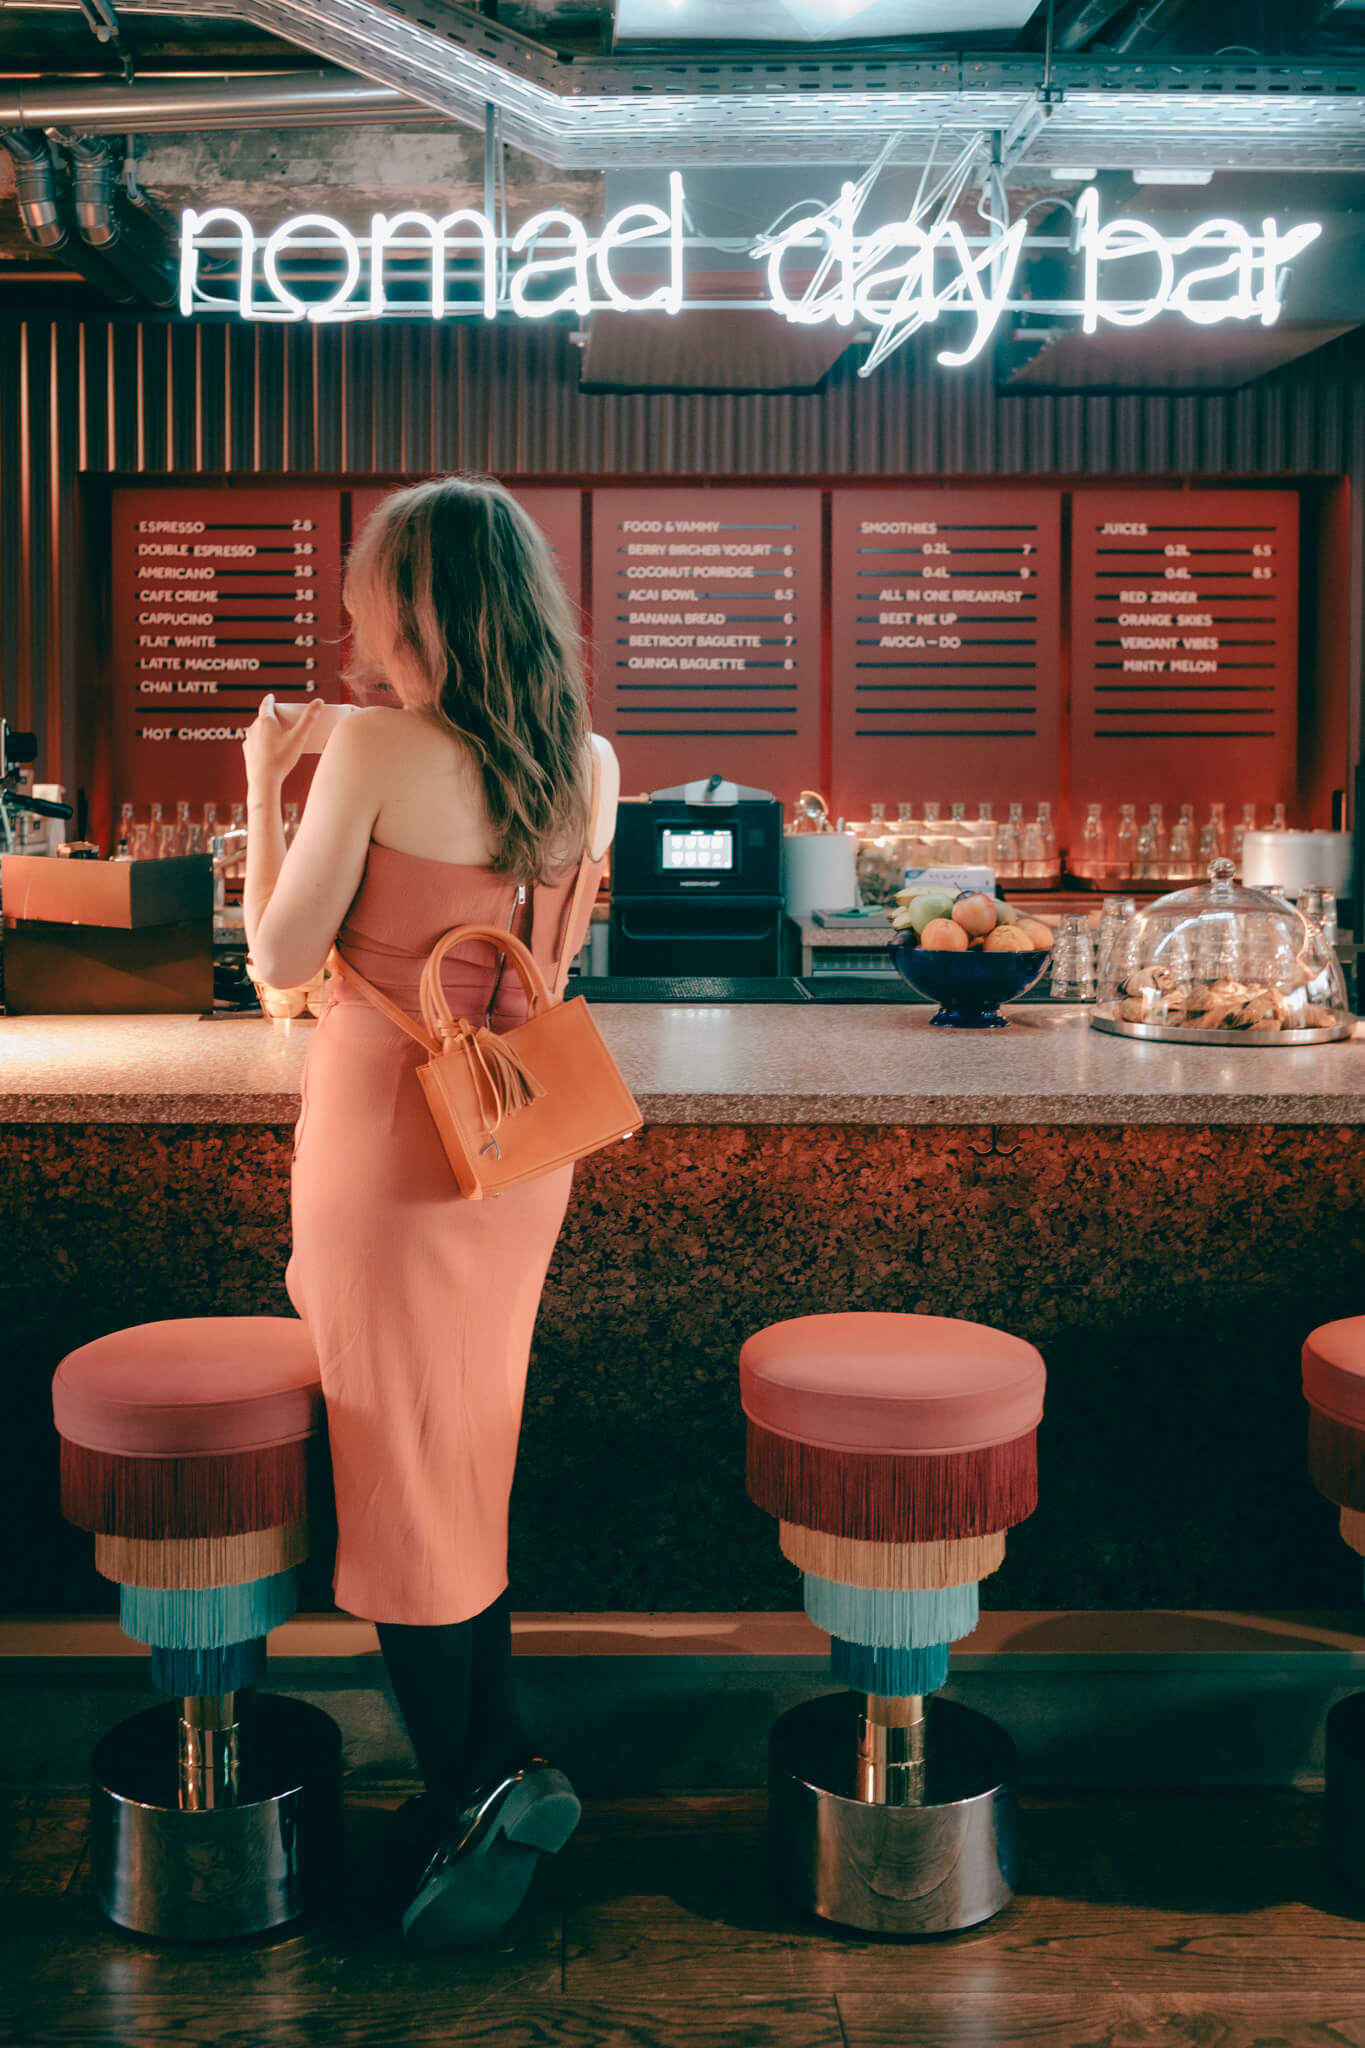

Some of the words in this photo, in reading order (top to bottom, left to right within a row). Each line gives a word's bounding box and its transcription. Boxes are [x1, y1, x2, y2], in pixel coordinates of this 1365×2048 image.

[179, 169, 686, 322] nomad
[767, 180, 1027, 367] day
[1081, 186, 1323, 335] bar
[139, 521, 205, 533] ESPRESSO
[623, 521, 662, 532] FOOD
[664, 521, 674, 532] &
[861, 521, 938, 534] SMOOTHIES
[1101, 522, 1148, 535] JUICES
[138, 544, 189, 556] DOUBLE
[193, 545, 257, 557] ESPRESSO
[627, 544, 666, 556] BERRY
[668, 544, 721, 556] BIRCHER
[723, 544, 773, 556] YOGURT
[138, 567, 215, 579] AMERICANO
[626, 566, 691, 578] COCONUT
[693, 566, 754, 578] PORRIDGE
[139, 590, 173, 602] CAFE
[175, 590, 219, 602] CREME
[628, 589, 659, 601] ACAI
[661, 589, 699, 601] BOWL
[879, 590, 904, 601] ALL
[906, 590, 921, 601] IN
[922, 590, 951, 601] ONE
[952, 590, 1023, 603] BREAKFAST
[1120, 591, 1147, 603] RED
[1151, 591, 1198, 603] ZINGER
[138, 612, 214, 625] CAPPUCINO
[629, 613, 682, 625] BANANA
[684, 613, 726, 625] BREAD
[879, 613, 913, 624] BEET
[916, 613, 937, 625] ME
[939, 613, 958, 625] UP
[1118, 614, 1172, 626] ORANGE
[1176, 614, 1213, 626] SKIES
[139, 636, 170, 647] FLAT
[174, 636, 216, 648] WHITE
[629, 635, 696, 647] BEETROOT
[697, 635, 761, 647] BAGUETTE
[879, 636, 926, 648] AVOCA
[939, 636, 961, 648] DO
[1120, 637, 1178, 650] VERDANT
[1182, 637, 1219, 650] VIBES
[140, 658, 181, 669] LATTE
[184, 658, 260, 671] MACCHIATO
[628, 658, 678, 670] QUINOA
[679, 658, 746, 670] BAGUETTE
[1123, 660, 1165, 672] MINTY
[1170, 660, 1218, 673] MELON
[140, 681, 172, 693] CHAI
[177, 681, 218, 693] LATTE
[143, 728, 172, 740] HOT
[178, 728, 247, 740] CHOCOLA
